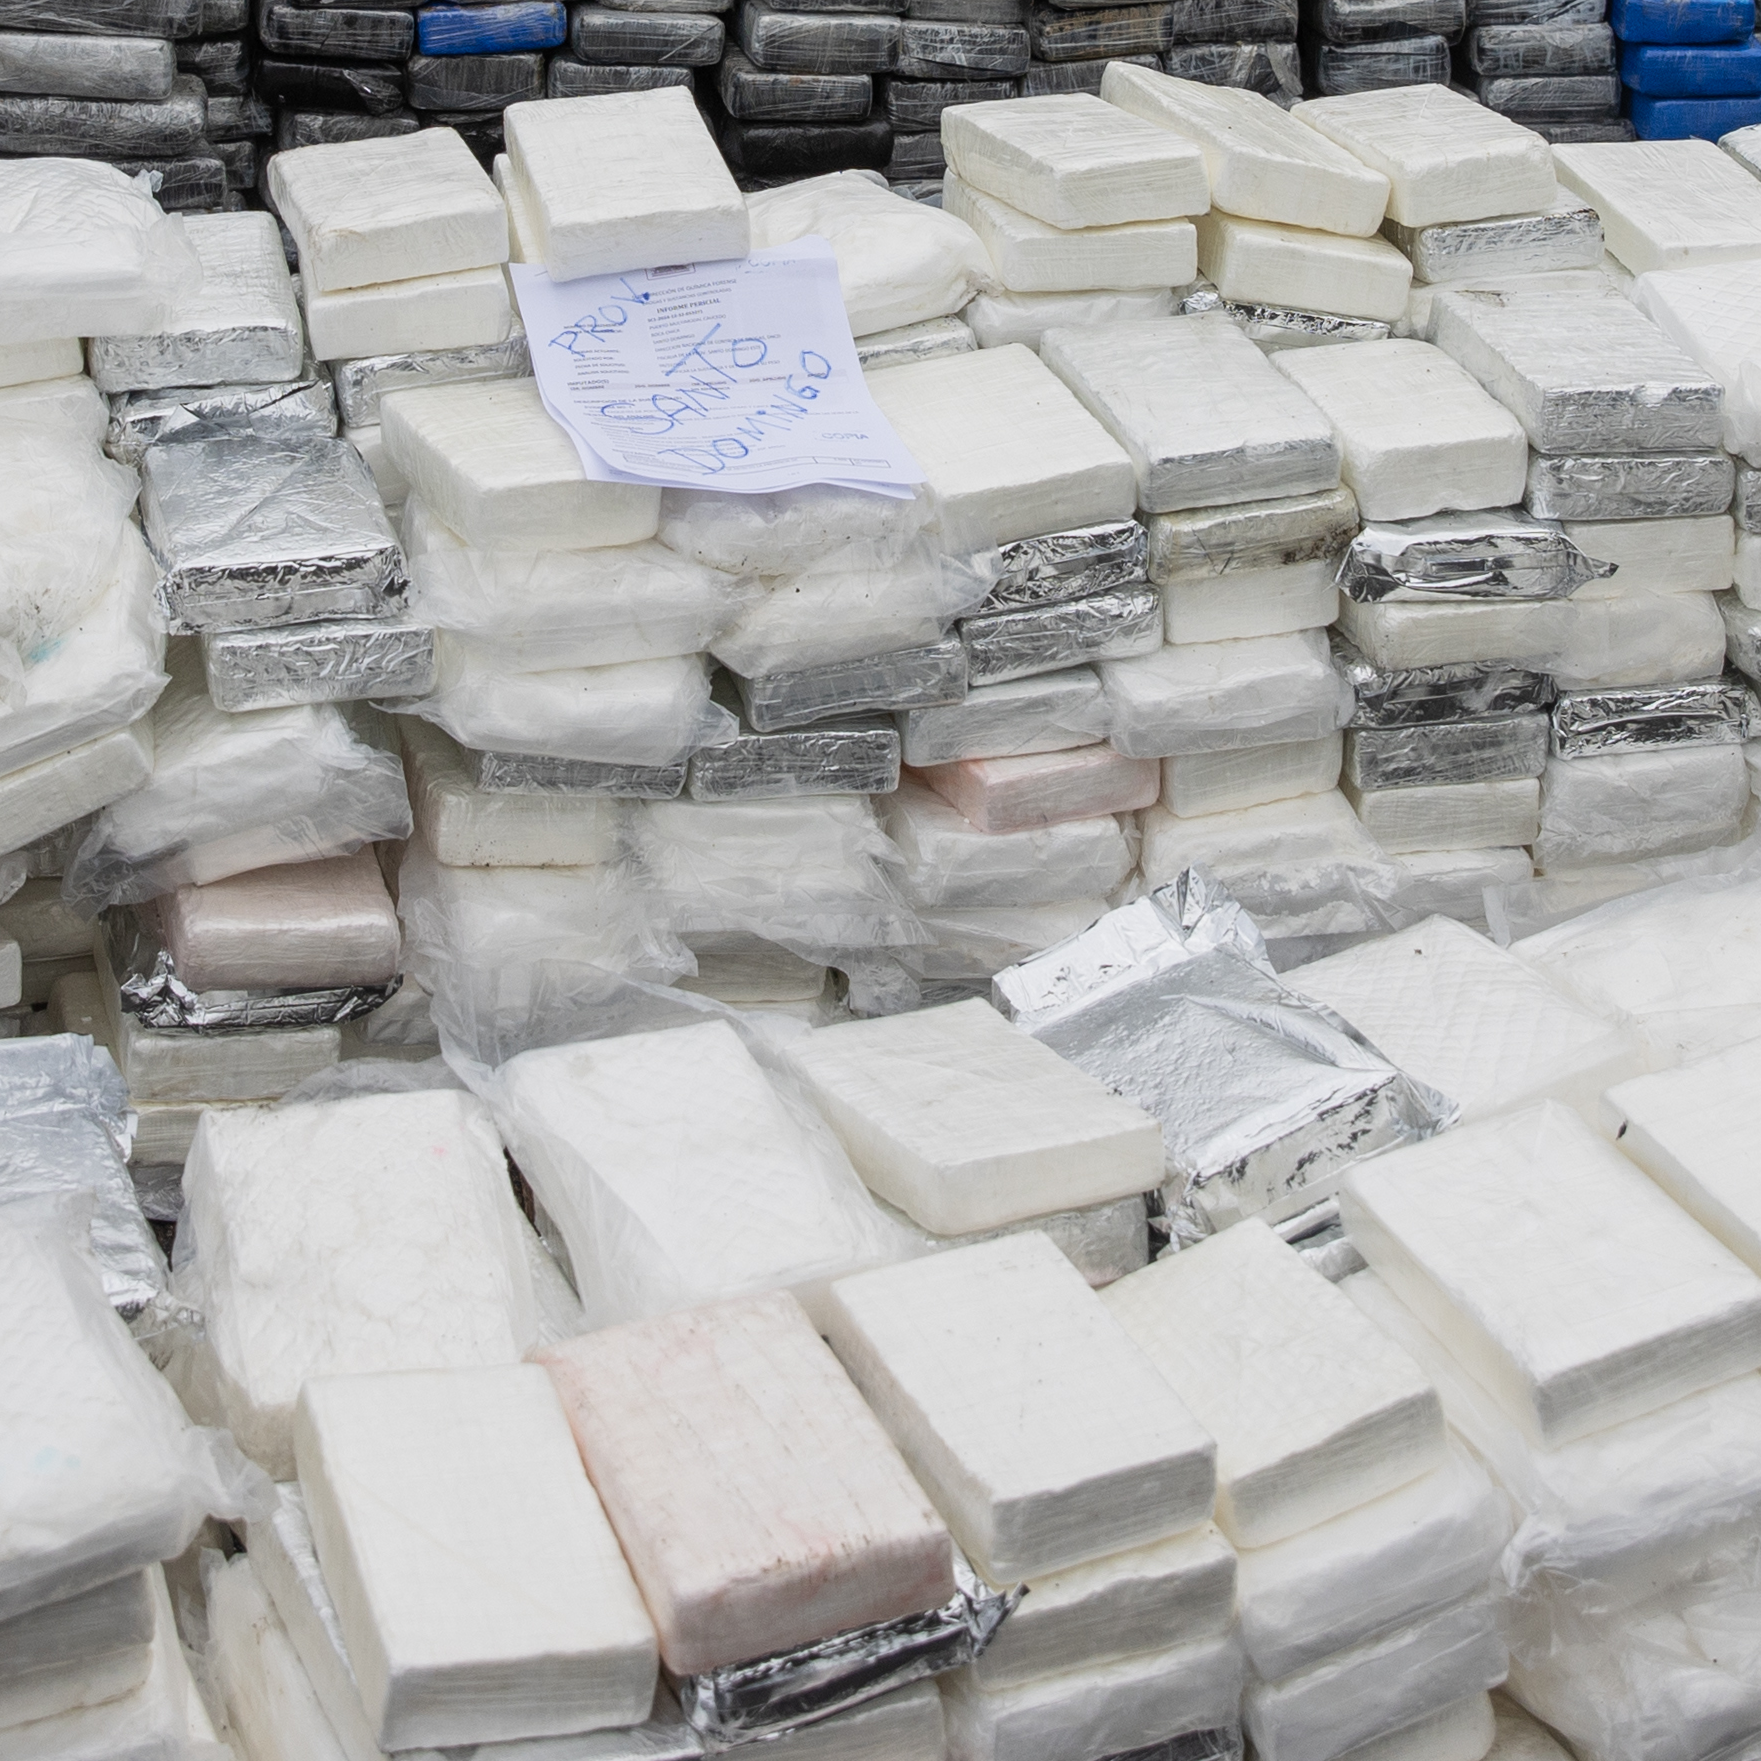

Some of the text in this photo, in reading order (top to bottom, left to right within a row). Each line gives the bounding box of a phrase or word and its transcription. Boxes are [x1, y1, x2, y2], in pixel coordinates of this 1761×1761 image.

[656, 298, 721, 314] INFORME PERICIAL
[601, 323, 768, 436] SANTO
[658, 350, 833, 475] DOMINGO
[821, 432, 869, 440] COPIA
